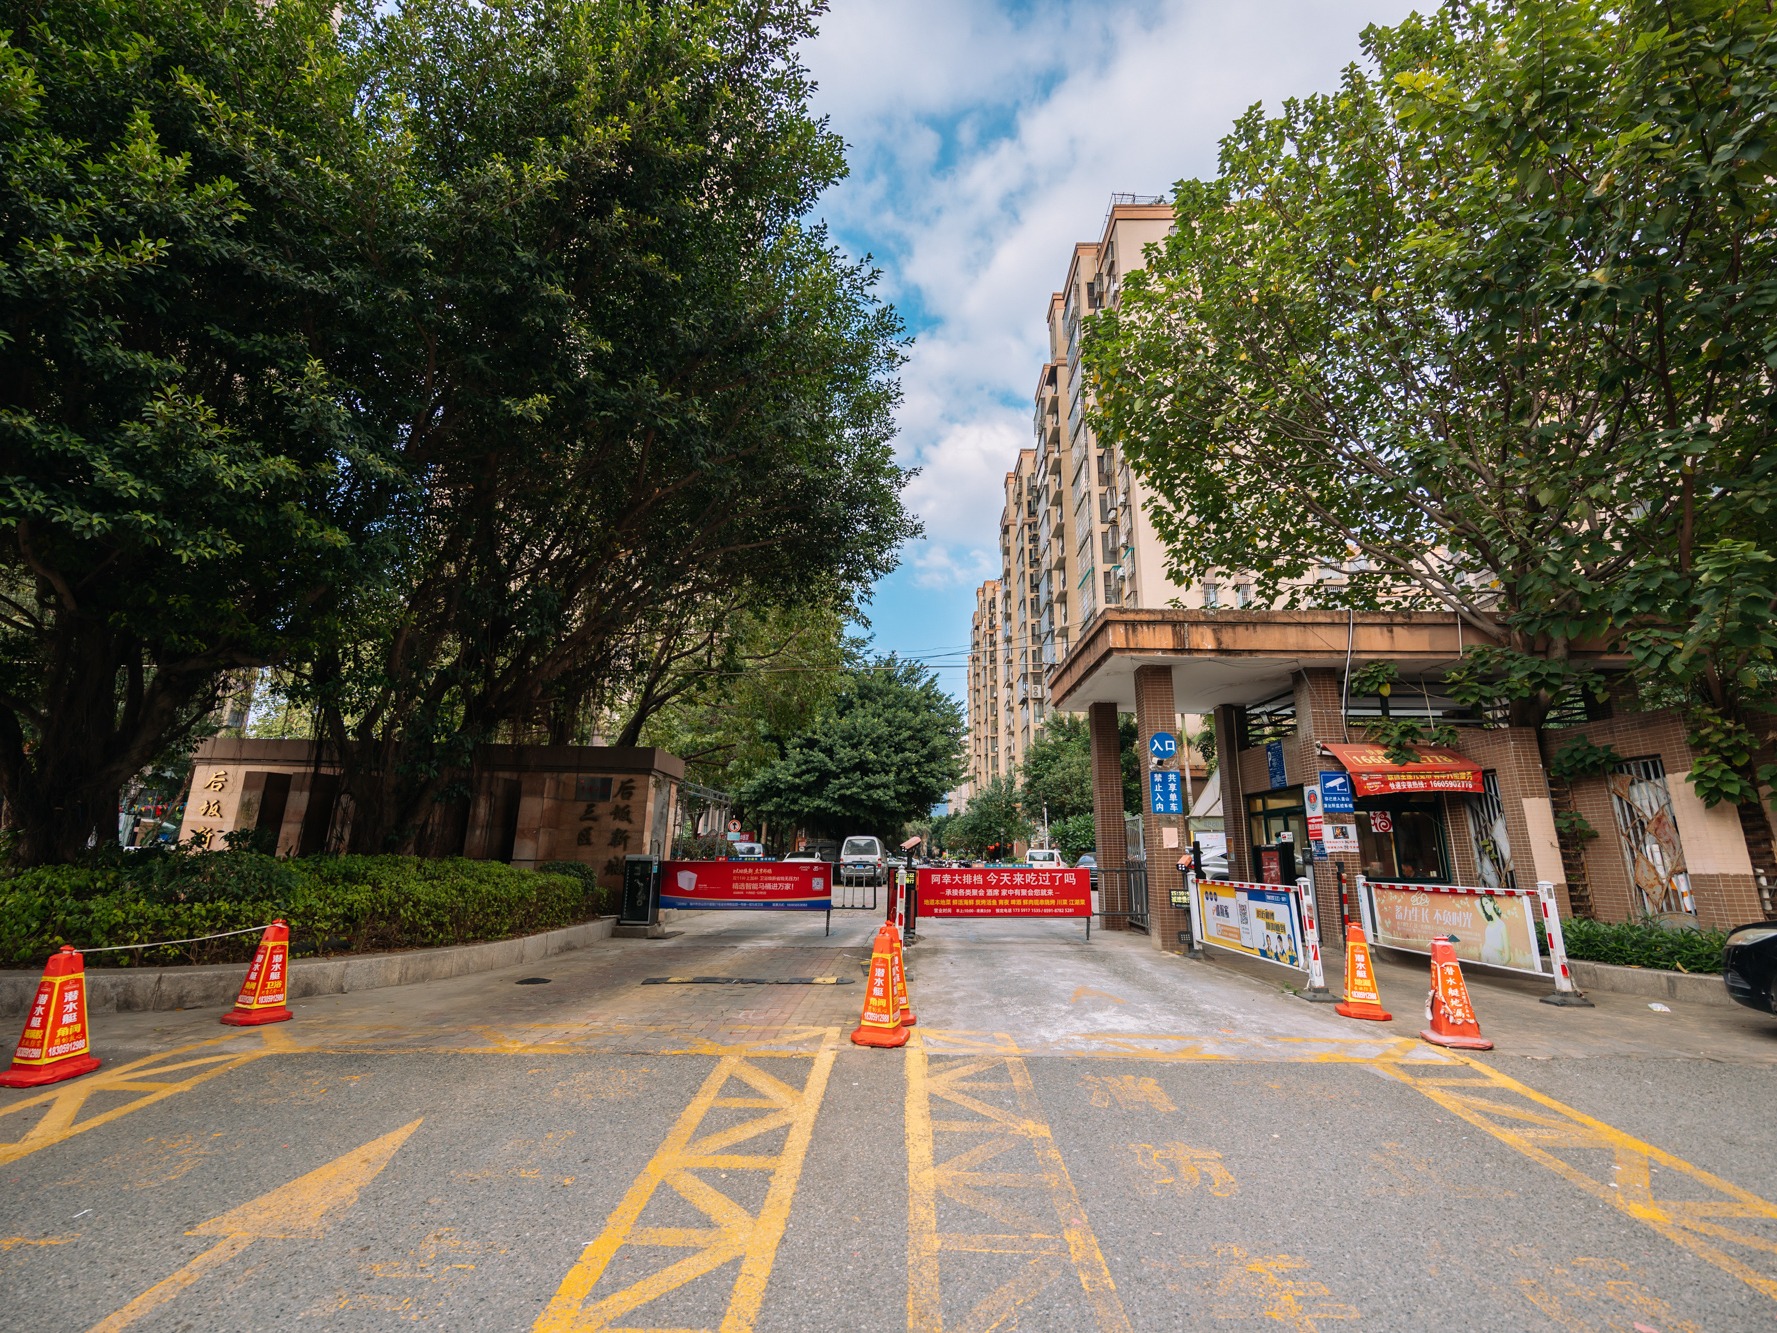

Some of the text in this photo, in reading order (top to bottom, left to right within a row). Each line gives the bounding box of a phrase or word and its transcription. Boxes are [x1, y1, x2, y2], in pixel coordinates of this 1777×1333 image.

[1152, 739, 1175, 751] 入口
[1352, 756, 1453, 764] 1660778
[1153, 773, 1164, 812] 禁止入内
[1167, 773, 1178, 812] 共享单车
[931, 872, 1076, 886] 阿幸大排档 今天来吃过了吗
[1394, 905, 1429, 924] 蓄力生长
[1433, 909, 1473, 928] 不负时光
[269, 954, 283, 980] 潜水艇
[1354, 954, 1367, 978] 潜水艇
[264, 980, 282, 990] 卫浴
[872, 968, 885, 996] 潜水艇
[30, 994, 49, 1028] 潜水艇
[62, 990, 79, 1025] 潜水艇
[56, 1023, 81, 1038] 角阀
